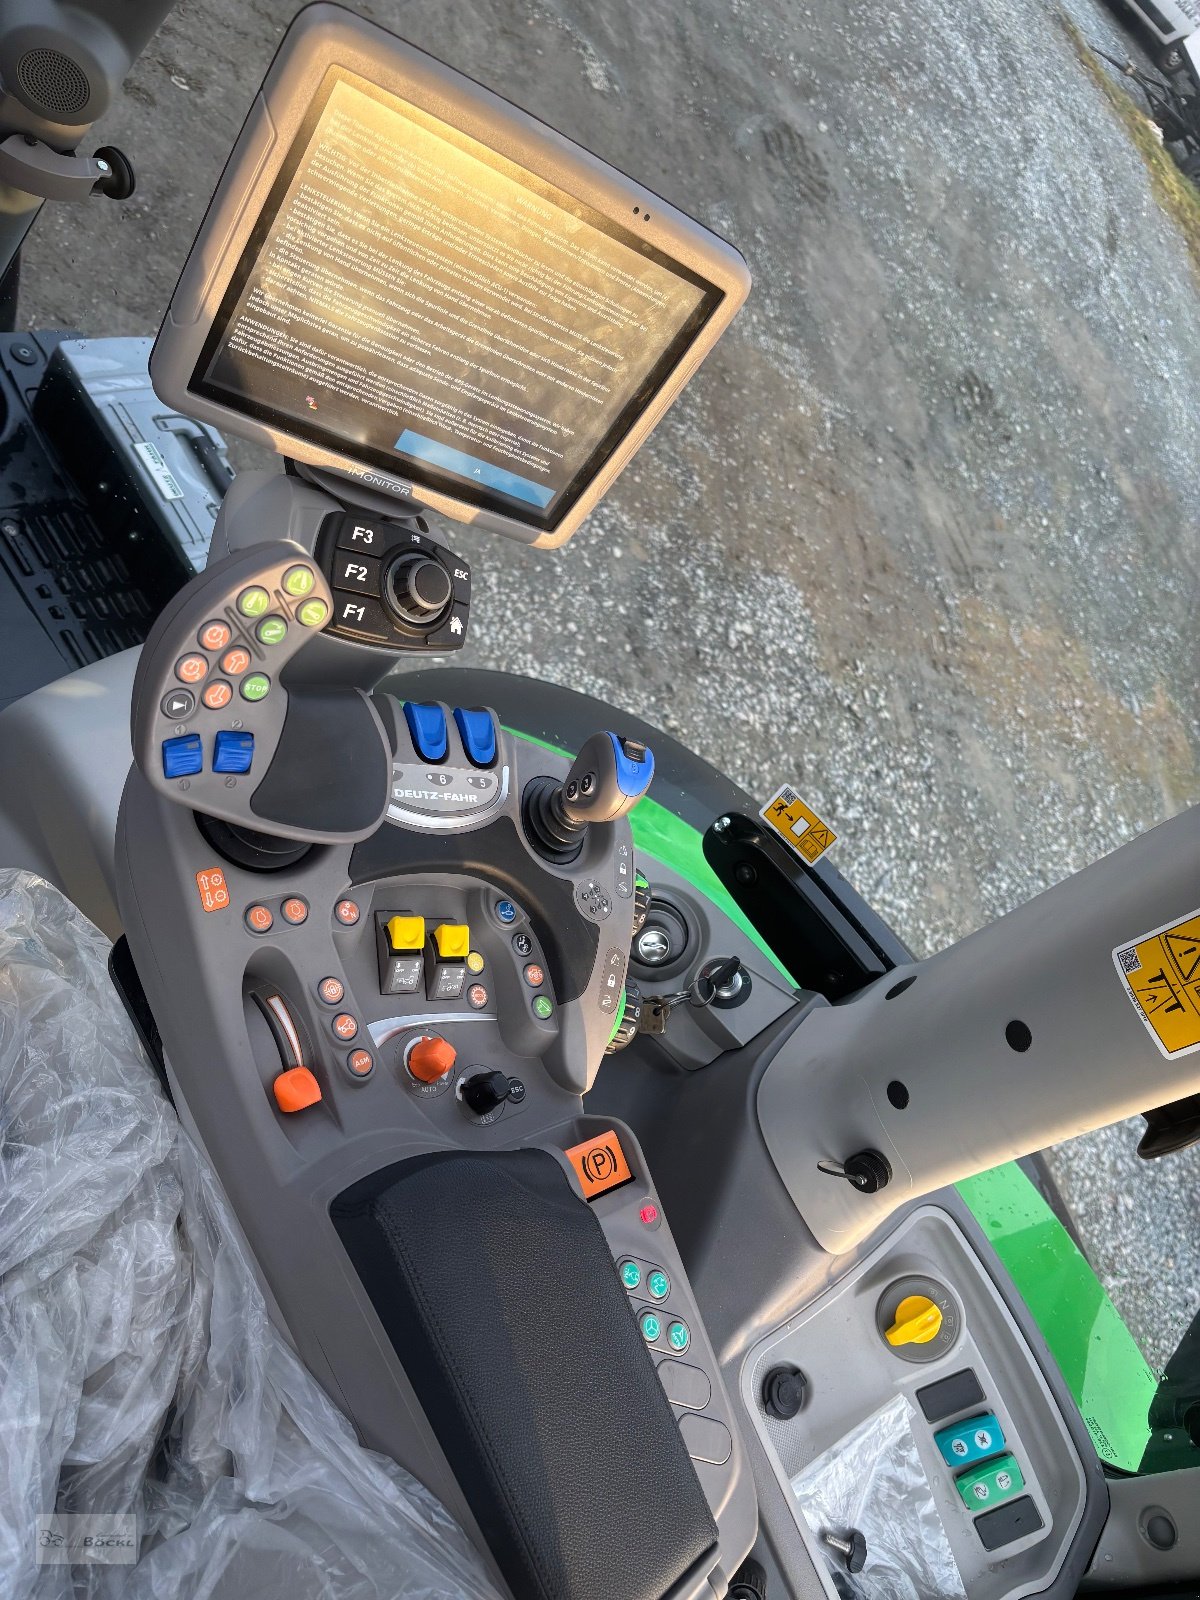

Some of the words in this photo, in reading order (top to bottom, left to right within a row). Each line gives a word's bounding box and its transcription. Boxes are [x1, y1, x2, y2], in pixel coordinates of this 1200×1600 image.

[515, 195, 552, 221] WARNUNG
[351, 526, 374, 544] F3
[344, 563, 368, 582] F2
[453, 568, 469, 581] ESC
[342, 603, 366, 622] F1
[245, 683, 268, 693] STOP
[439, 774, 447, 785] 6
[479, 778, 486, 788] 5
[393, 788, 478, 803] DEUTZ-FAHR
[639, 913, 646, 923] 8
[635, 1007, 641, 1018] 8
[627, 1026, 636, 1036] 9
[354, 1057, 370, 1068] ASM
[510, 1085, 524, 1094] ESC
[592, 1153, 605, 1176] P
